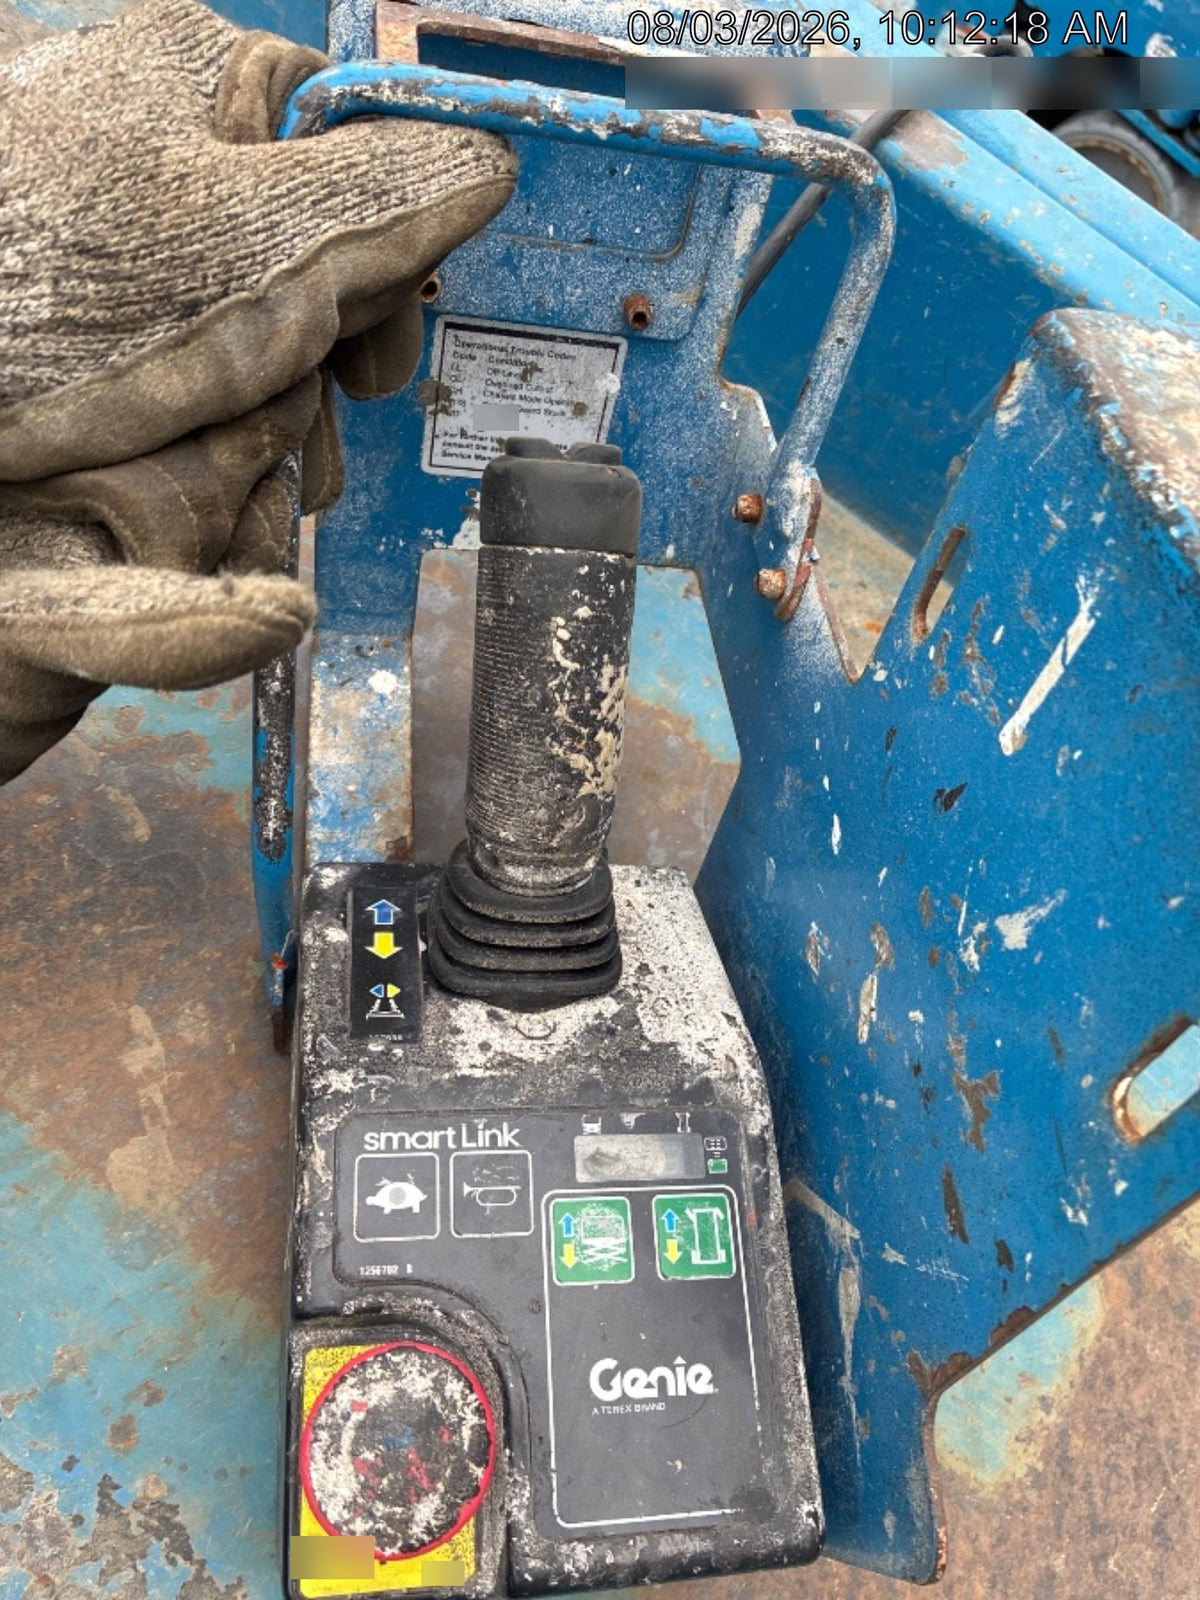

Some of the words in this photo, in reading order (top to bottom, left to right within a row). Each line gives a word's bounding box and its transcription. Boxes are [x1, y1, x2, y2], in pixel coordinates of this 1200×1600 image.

[589, 1355, 714, 1402] Genie
[591, 1406, 600, 1416] A
[600, 1403, 632, 1415] TEREX
[634, 1401, 666, 1413] BRAND
